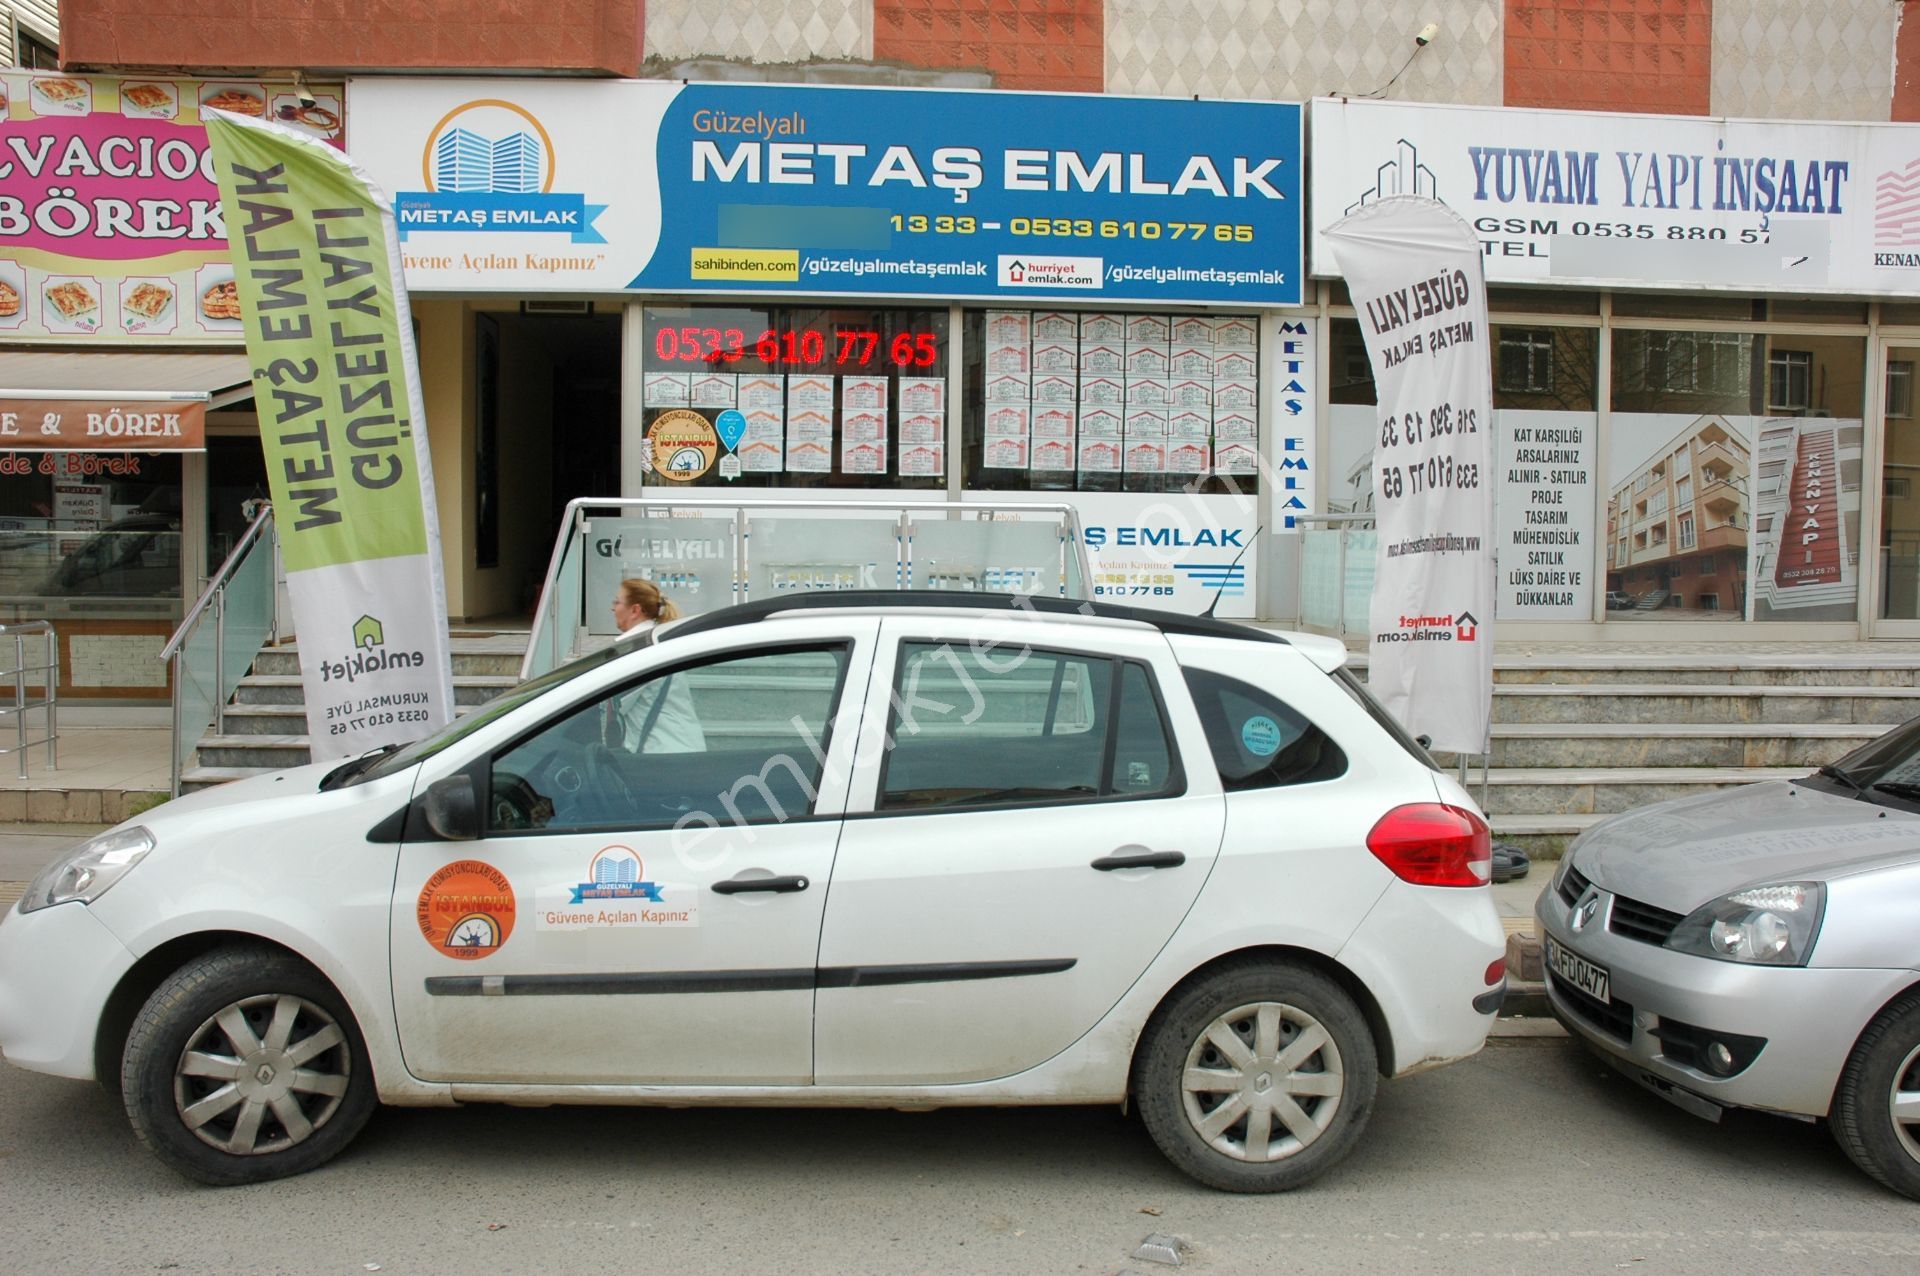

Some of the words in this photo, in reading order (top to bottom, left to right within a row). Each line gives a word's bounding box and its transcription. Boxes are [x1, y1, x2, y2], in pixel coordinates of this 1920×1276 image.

[692, 110, 807, 140] Güzelyalı
[0, 136, 218, 181] VACIO
[691, 140, 984, 204] METAŞ
[1003, 149, 1287, 201] EMLAK
[1467, 146, 1599, 206] YUVAM
[1615, 151, 1704, 211] YAPI
[1712, 138, 1849, 231] İNŞAAT
[400, 209, 487, 228] METAŞ
[491, 210, 578, 225] EMLAK
[934, 215, 977, 234] 33
[1010, 217, 1093, 238] 0533
[1099, 220, 1161, 239] 610
[1167, 222, 1207, 241] 77
[1213, 223, 1254, 242] 65
[1474, 218, 1558, 235] GSM
[1572, 221, 1654, 239] 0535
[1480, 240, 1548, 258] TEL
[458, 253, 519, 273] Açılan
[694, 258, 796, 272] sahibinden.com
[1027, 262, 1076, 276] hurriyet
[1027, 273, 1094, 285] emlak.com
[656, 327, 744, 362] 0533
[756, 329, 825, 364] 610
[836, 331, 879, 366] 77
[891, 332, 937, 367] 65
[1278, 321, 1309, 417] METAŞ
[40, 414, 61, 435] &
[87, 407, 182, 437] BÖREK
[1514, 428, 1532, 443] KAT
[1535, 426, 1582, 447] KARŞILIĞI
[38, 453, 57, 474] &
[67, 452, 140, 475] Börek
[1516, 449, 1580, 464] ARSALARINIZ
[1508, 469, 1540, 484] ALINIR
[1550, 470, 1587, 485] SATILIR
[1806, 452, 1822, 500] KENAN
[1531, 490, 1563, 504] PROJE
[1525, 510, 1568, 525] TASARIM
[1116, 527, 1243, 547] EMLAK
[1513, 528, 1580, 545] MÜHENDİSLİK
[1802, 504, 1820, 565] YAPI
[1528, 551, 1564, 565] SATILIK
[1510, 568, 1534, 586] LÜKS
[1537, 568, 1566, 586] DAİRE
[1569, 571, 1581, 586] VE
[1129, 586, 1149, 595] 77
[1516, 589, 1573, 606] DÜKKANLAR
[598, 910, 637, 926] Açılan
[454, 948, 479, 957] 1999
